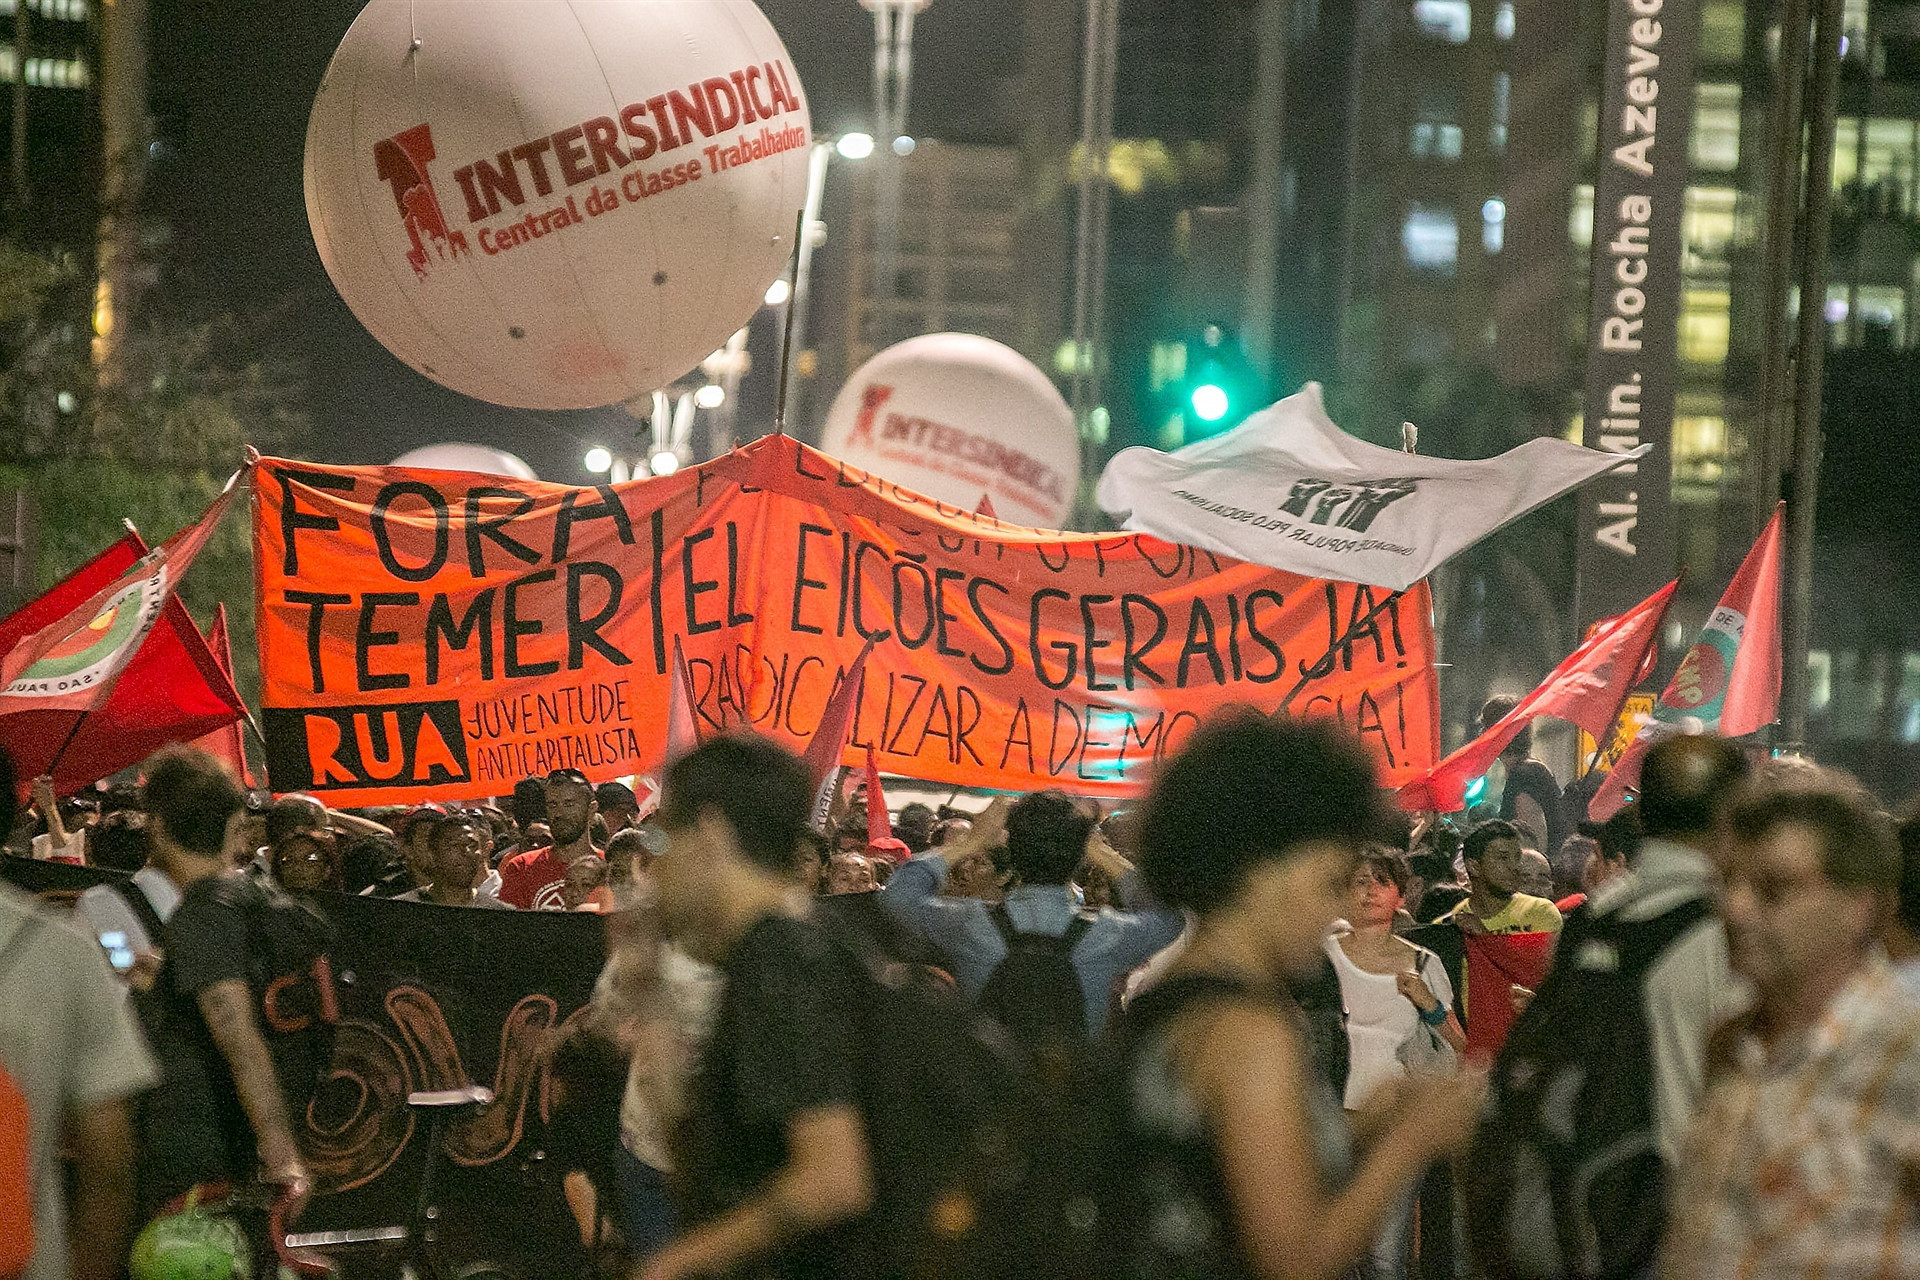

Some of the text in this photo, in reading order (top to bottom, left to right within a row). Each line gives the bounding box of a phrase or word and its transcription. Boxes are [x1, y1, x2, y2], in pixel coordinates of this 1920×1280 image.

[453, 59, 800, 224] INTERSINDICAL
[477, 121, 806, 256] Central da Classe Trabalhadora
[1602, 195, 1652, 350] Rocha
[274, 468, 637, 582] FORA
[284, 561, 633, 694] TEMER
[1029, 588, 1287, 691] GERAIS
[303, 711, 463, 786] RUA
[467, 680, 632, 740] JUVENTUDE
[477, 727, 642, 781] ANTICAPITALISTA
[1000, 696, 1034, 775] A
